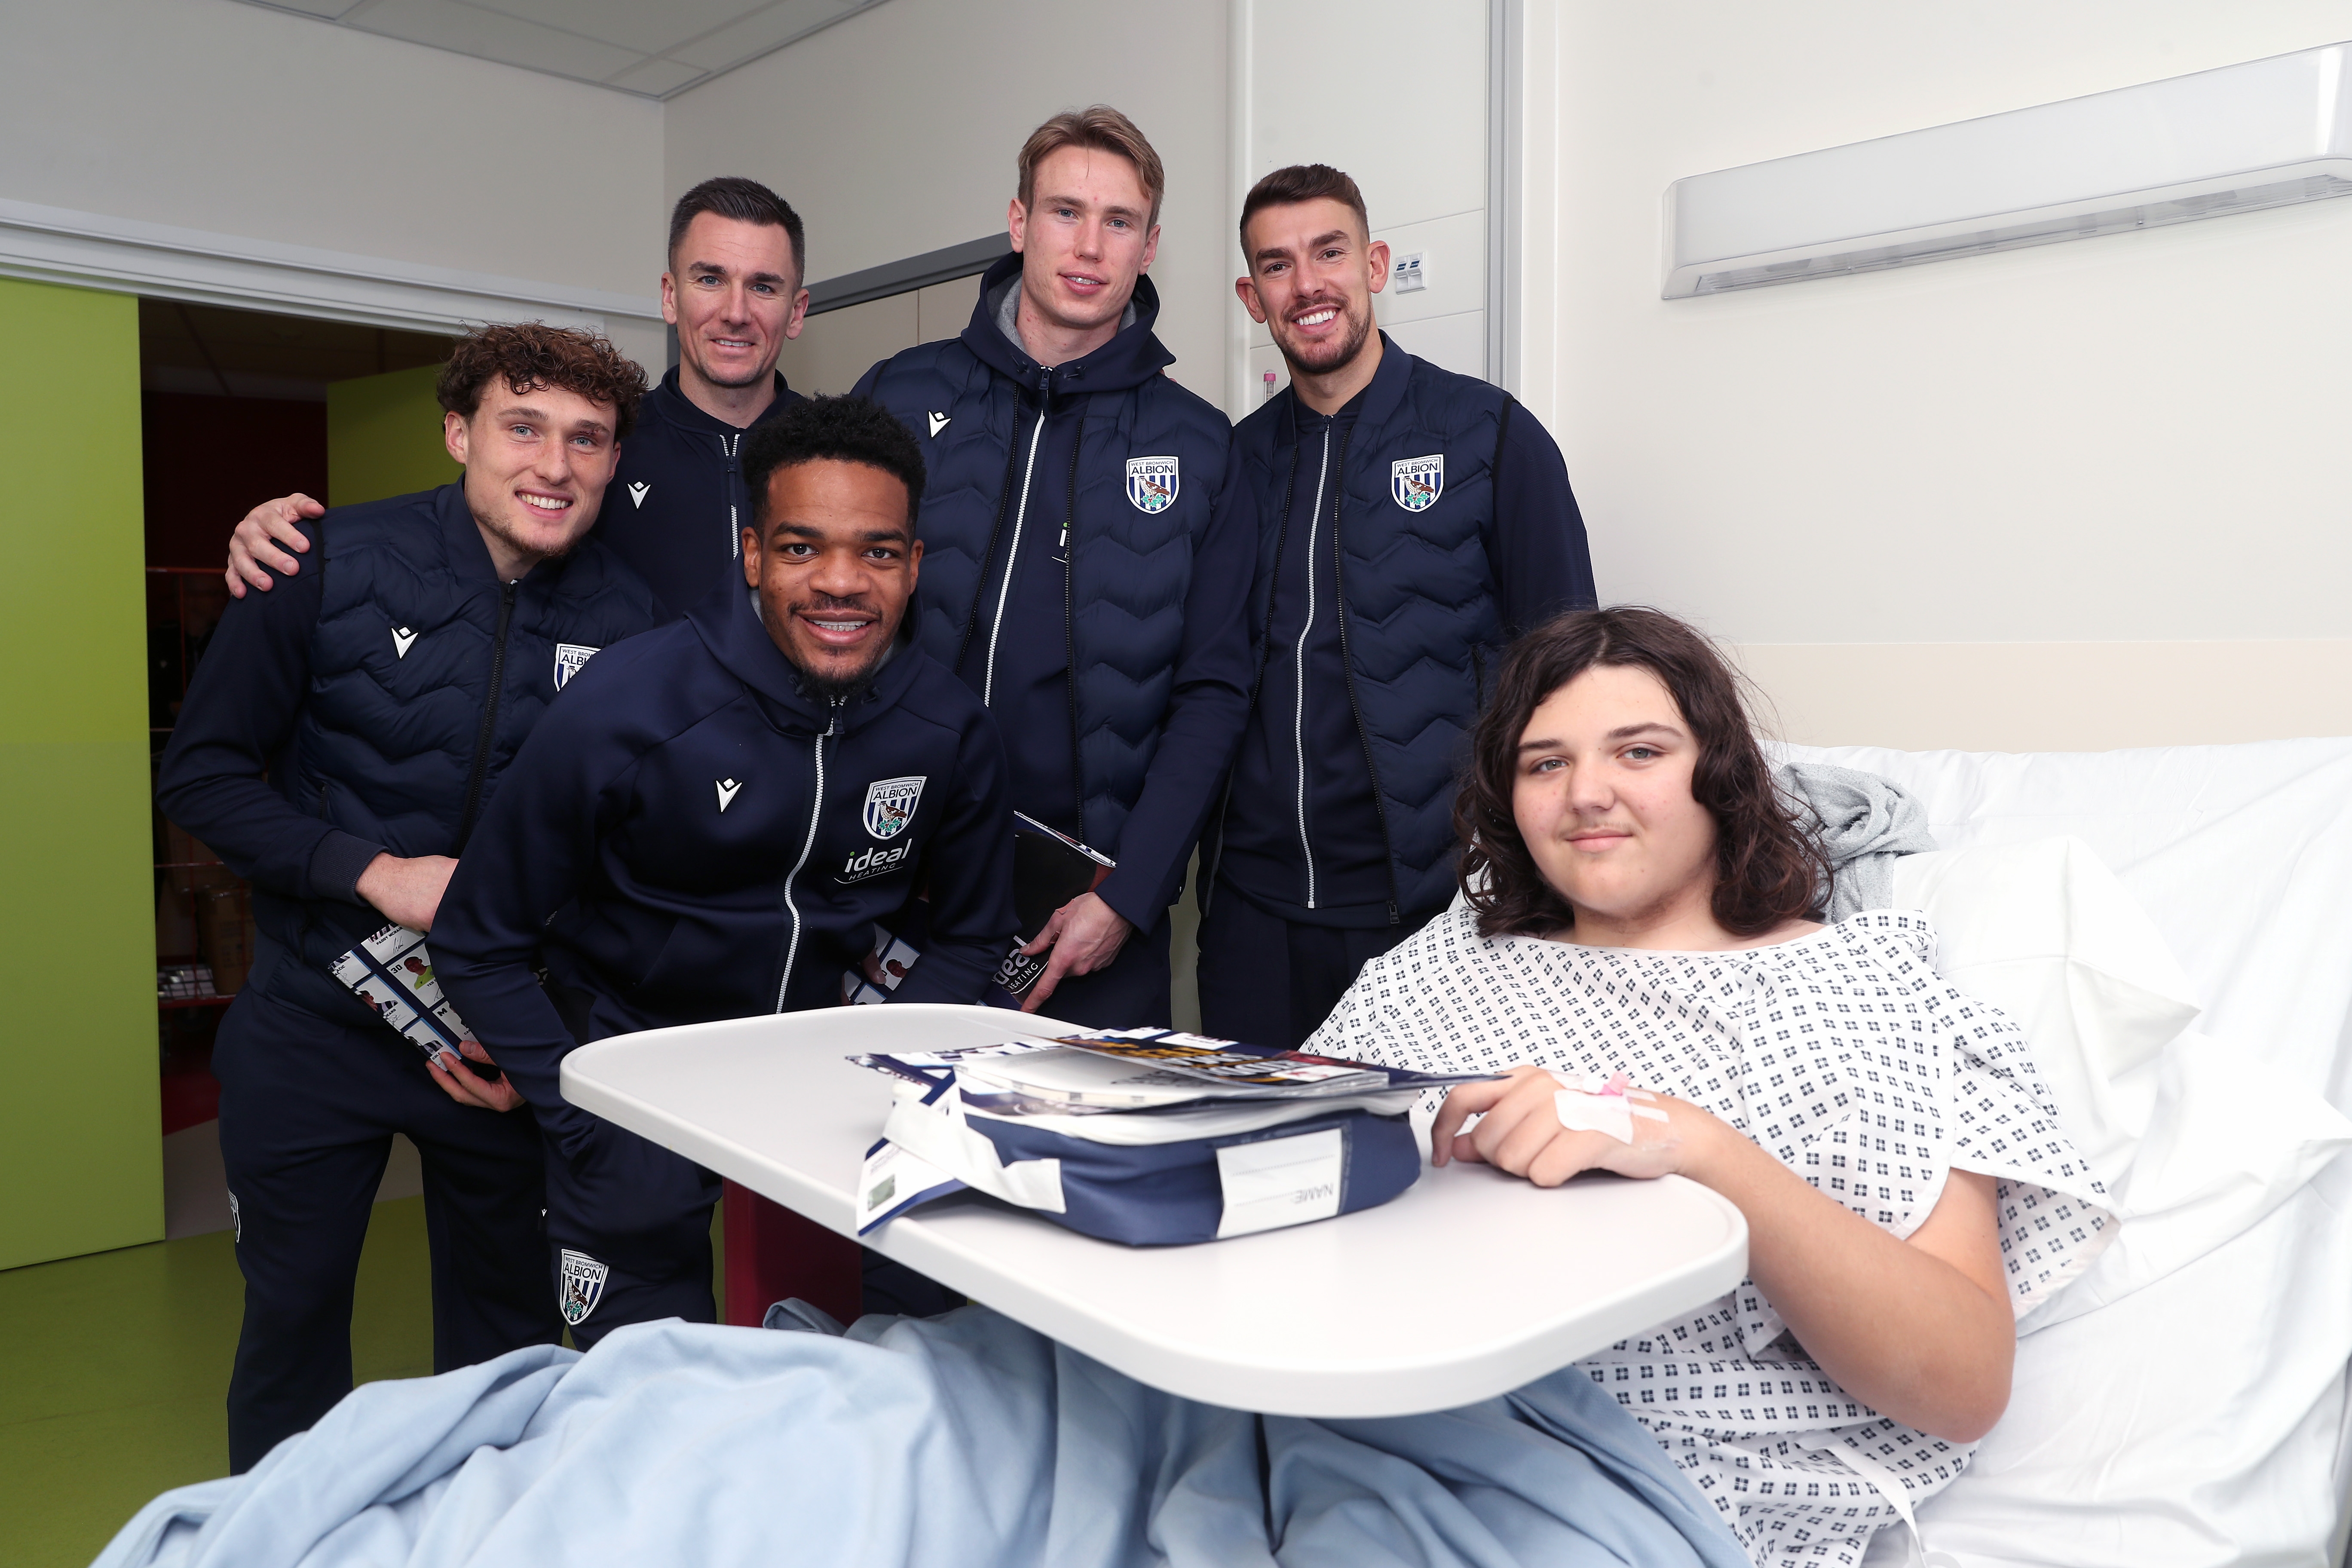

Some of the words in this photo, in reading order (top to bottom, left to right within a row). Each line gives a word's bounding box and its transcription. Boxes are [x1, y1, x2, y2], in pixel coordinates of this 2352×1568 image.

[1131, 465, 1173, 475] ALBION
[1397, 463, 1438, 475] ALBION
[873, 787, 917, 800] ALBION
[845, 838, 912, 873] ideal
[849, 863, 896, 880] HEATING
[390, 964, 403, 974] 30
[437, 1007, 448, 1017] M
[576, 1260, 603, 1269] BROMWICH
[564, 1262, 601, 1280] ALBION
